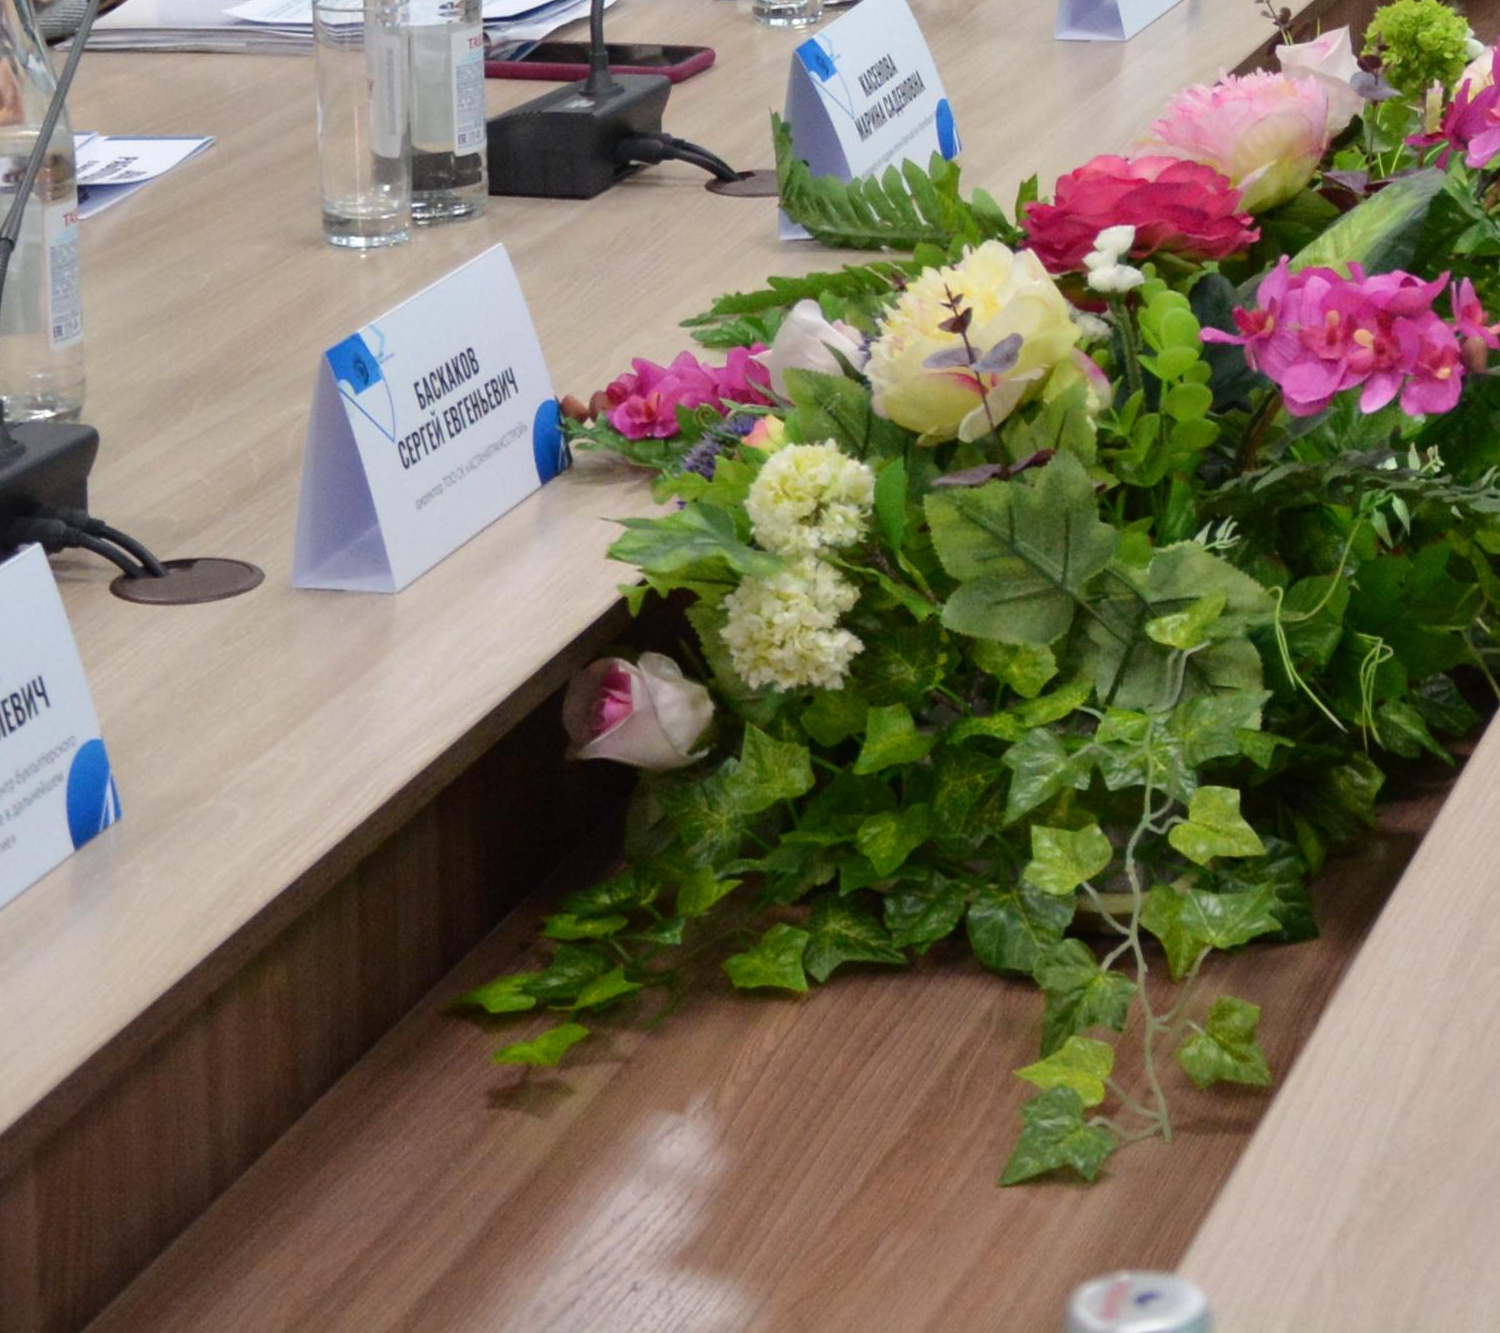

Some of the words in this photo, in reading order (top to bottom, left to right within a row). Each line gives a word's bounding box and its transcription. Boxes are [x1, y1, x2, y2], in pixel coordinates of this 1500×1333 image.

[397, 409, 442, 470] СЕРГЕЙ
[446, 367, 520, 439] ЕВГЕНЬЕВИЧ
[413, 347, 480, 411] БАСКАКОВ
